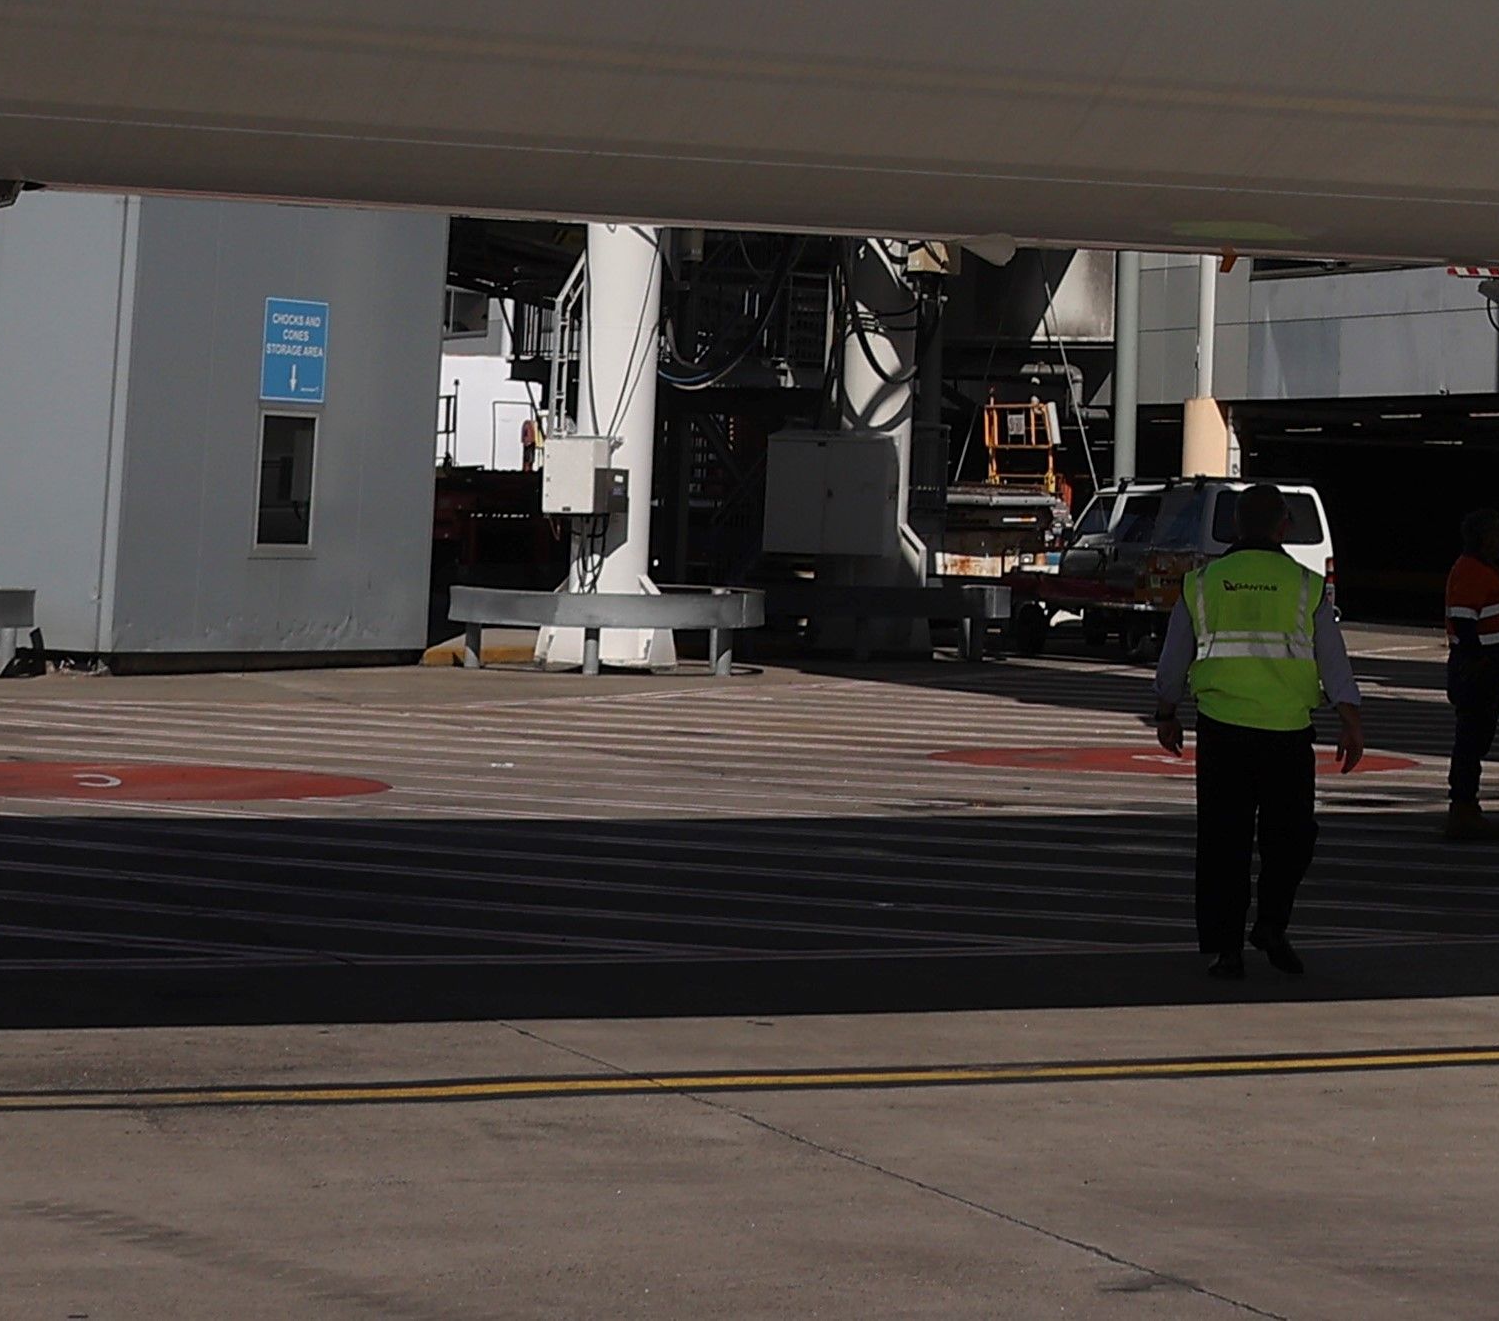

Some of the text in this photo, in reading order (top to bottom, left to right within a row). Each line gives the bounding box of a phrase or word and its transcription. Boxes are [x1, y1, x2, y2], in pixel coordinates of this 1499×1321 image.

[272, 313, 321, 327] CHOCKS AND
[283, 329, 309, 341] CONES
[266, 343, 323, 357] STORAGE AREA
[1235, 582, 1278, 592] QANTAS
